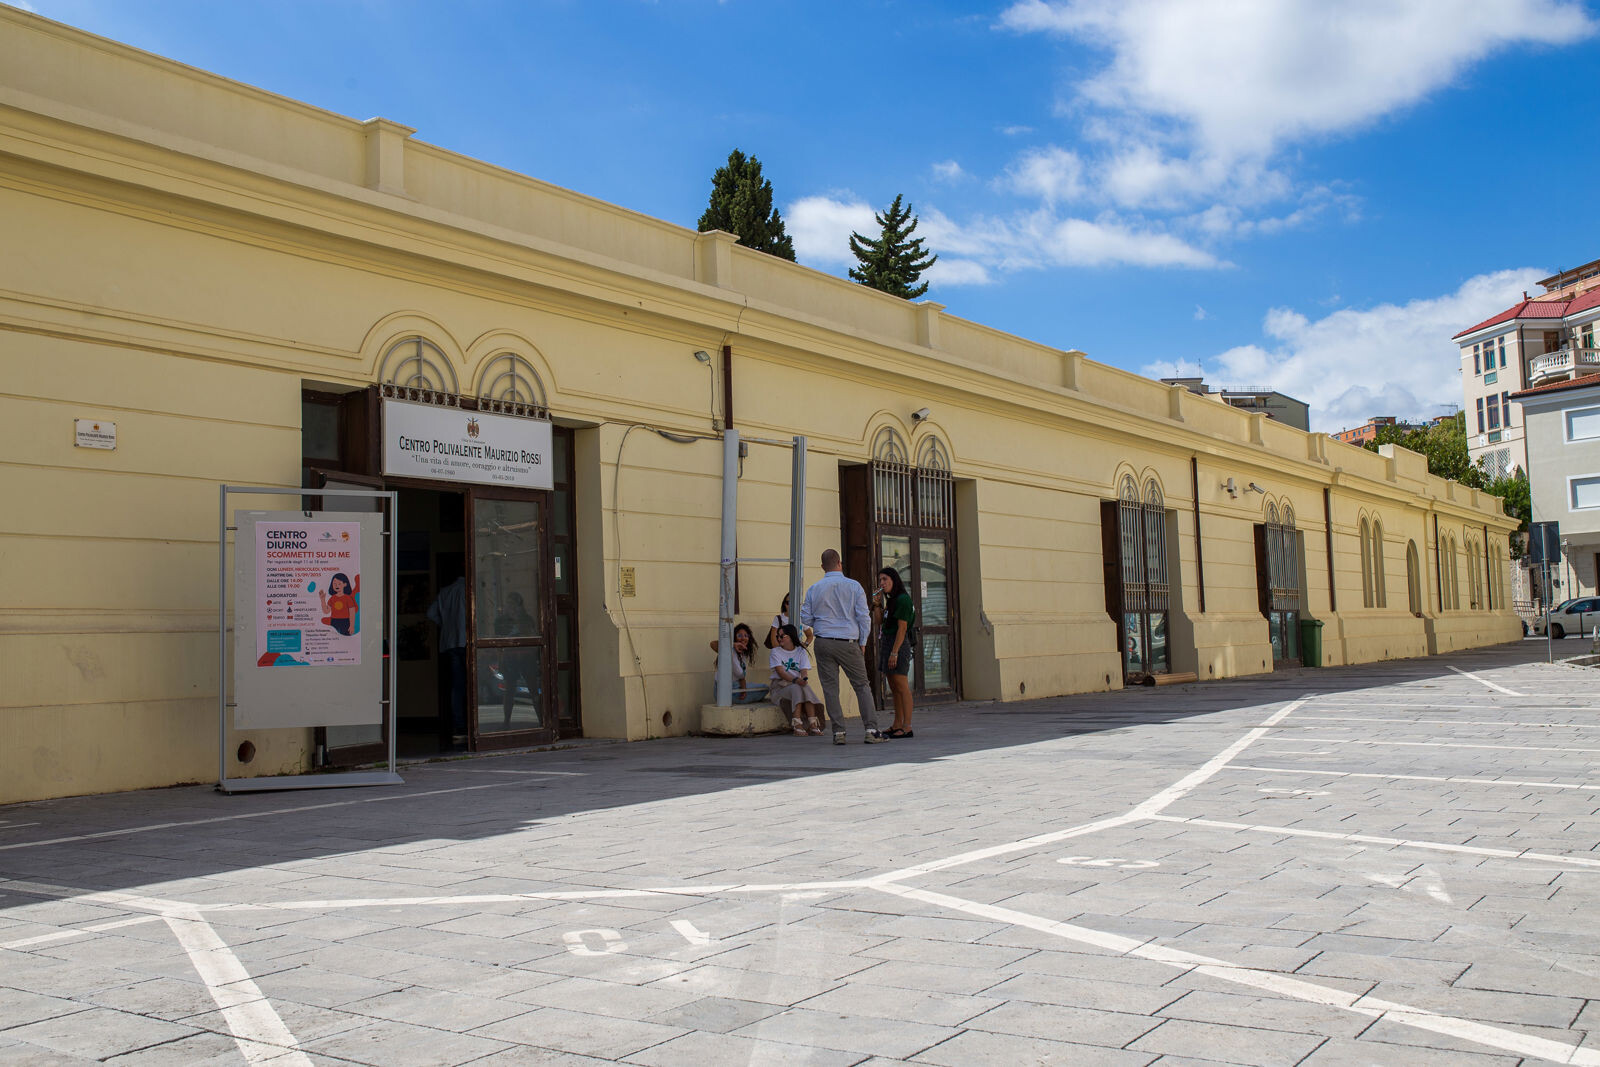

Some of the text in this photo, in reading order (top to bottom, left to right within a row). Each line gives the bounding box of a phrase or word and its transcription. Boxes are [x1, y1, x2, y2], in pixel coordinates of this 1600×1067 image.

[399, 436, 542, 465] CENTRO POLIVALENTE MAURIZIO ROSSI
[430, 456, 442, 465] vita
[472, 463, 496, 472] coraggio
[266, 531, 307, 539] CENTRO
[267, 541, 307, 549] DIURNO
